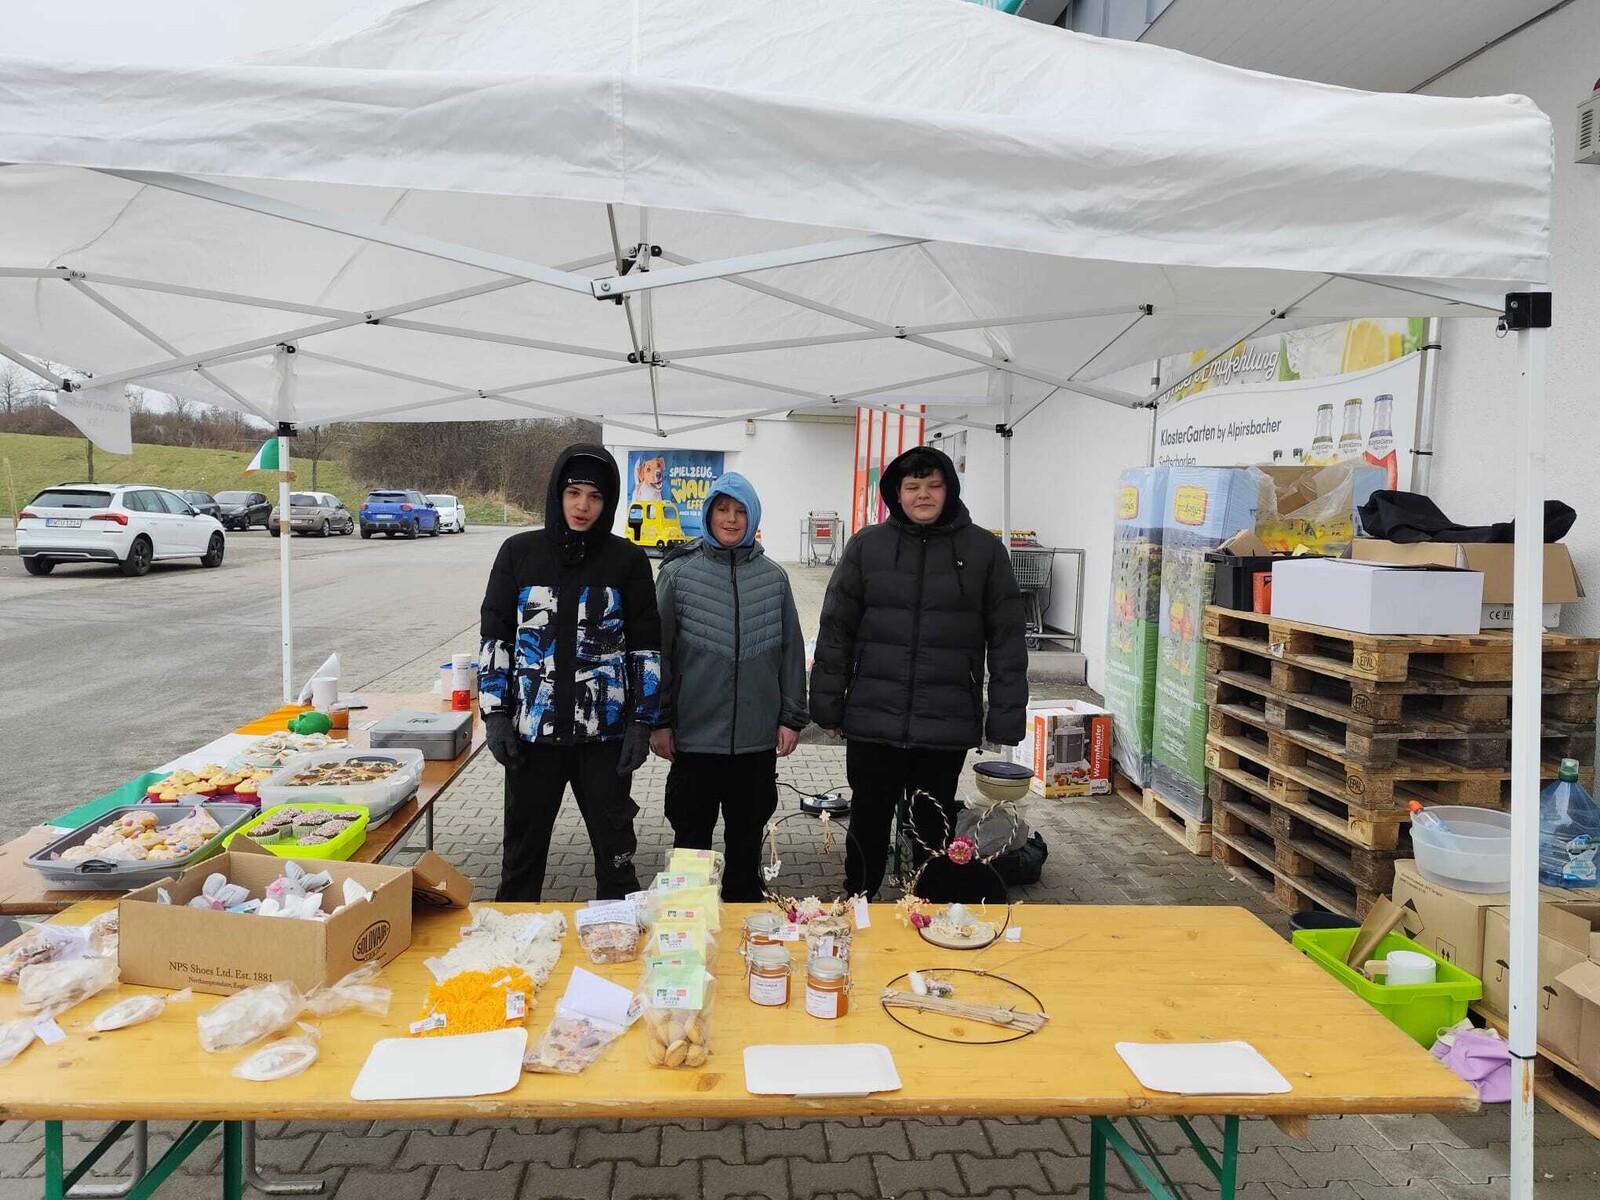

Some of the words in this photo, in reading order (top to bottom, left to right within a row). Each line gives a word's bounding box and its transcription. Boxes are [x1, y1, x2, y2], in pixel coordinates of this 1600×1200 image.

[1201, 344, 1280, 385] Empfehlung
[1160, 424, 1215, 447] KlosterGarten
[1217, 424, 1225, 443] by
[1227, 416, 1282, 441] Alpirsbacher
[1360, 655, 1375, 668] EPAL
[1094, 724, 1102, 778] WarmMaster
[169, 961, 188, 972] NPS
[190, 963, 214, 976] Shoes
[216, 967, 234, 979] Ltd.
[235, 969, 252, 981] Est.
[253, 971, 273, 983] 1881
